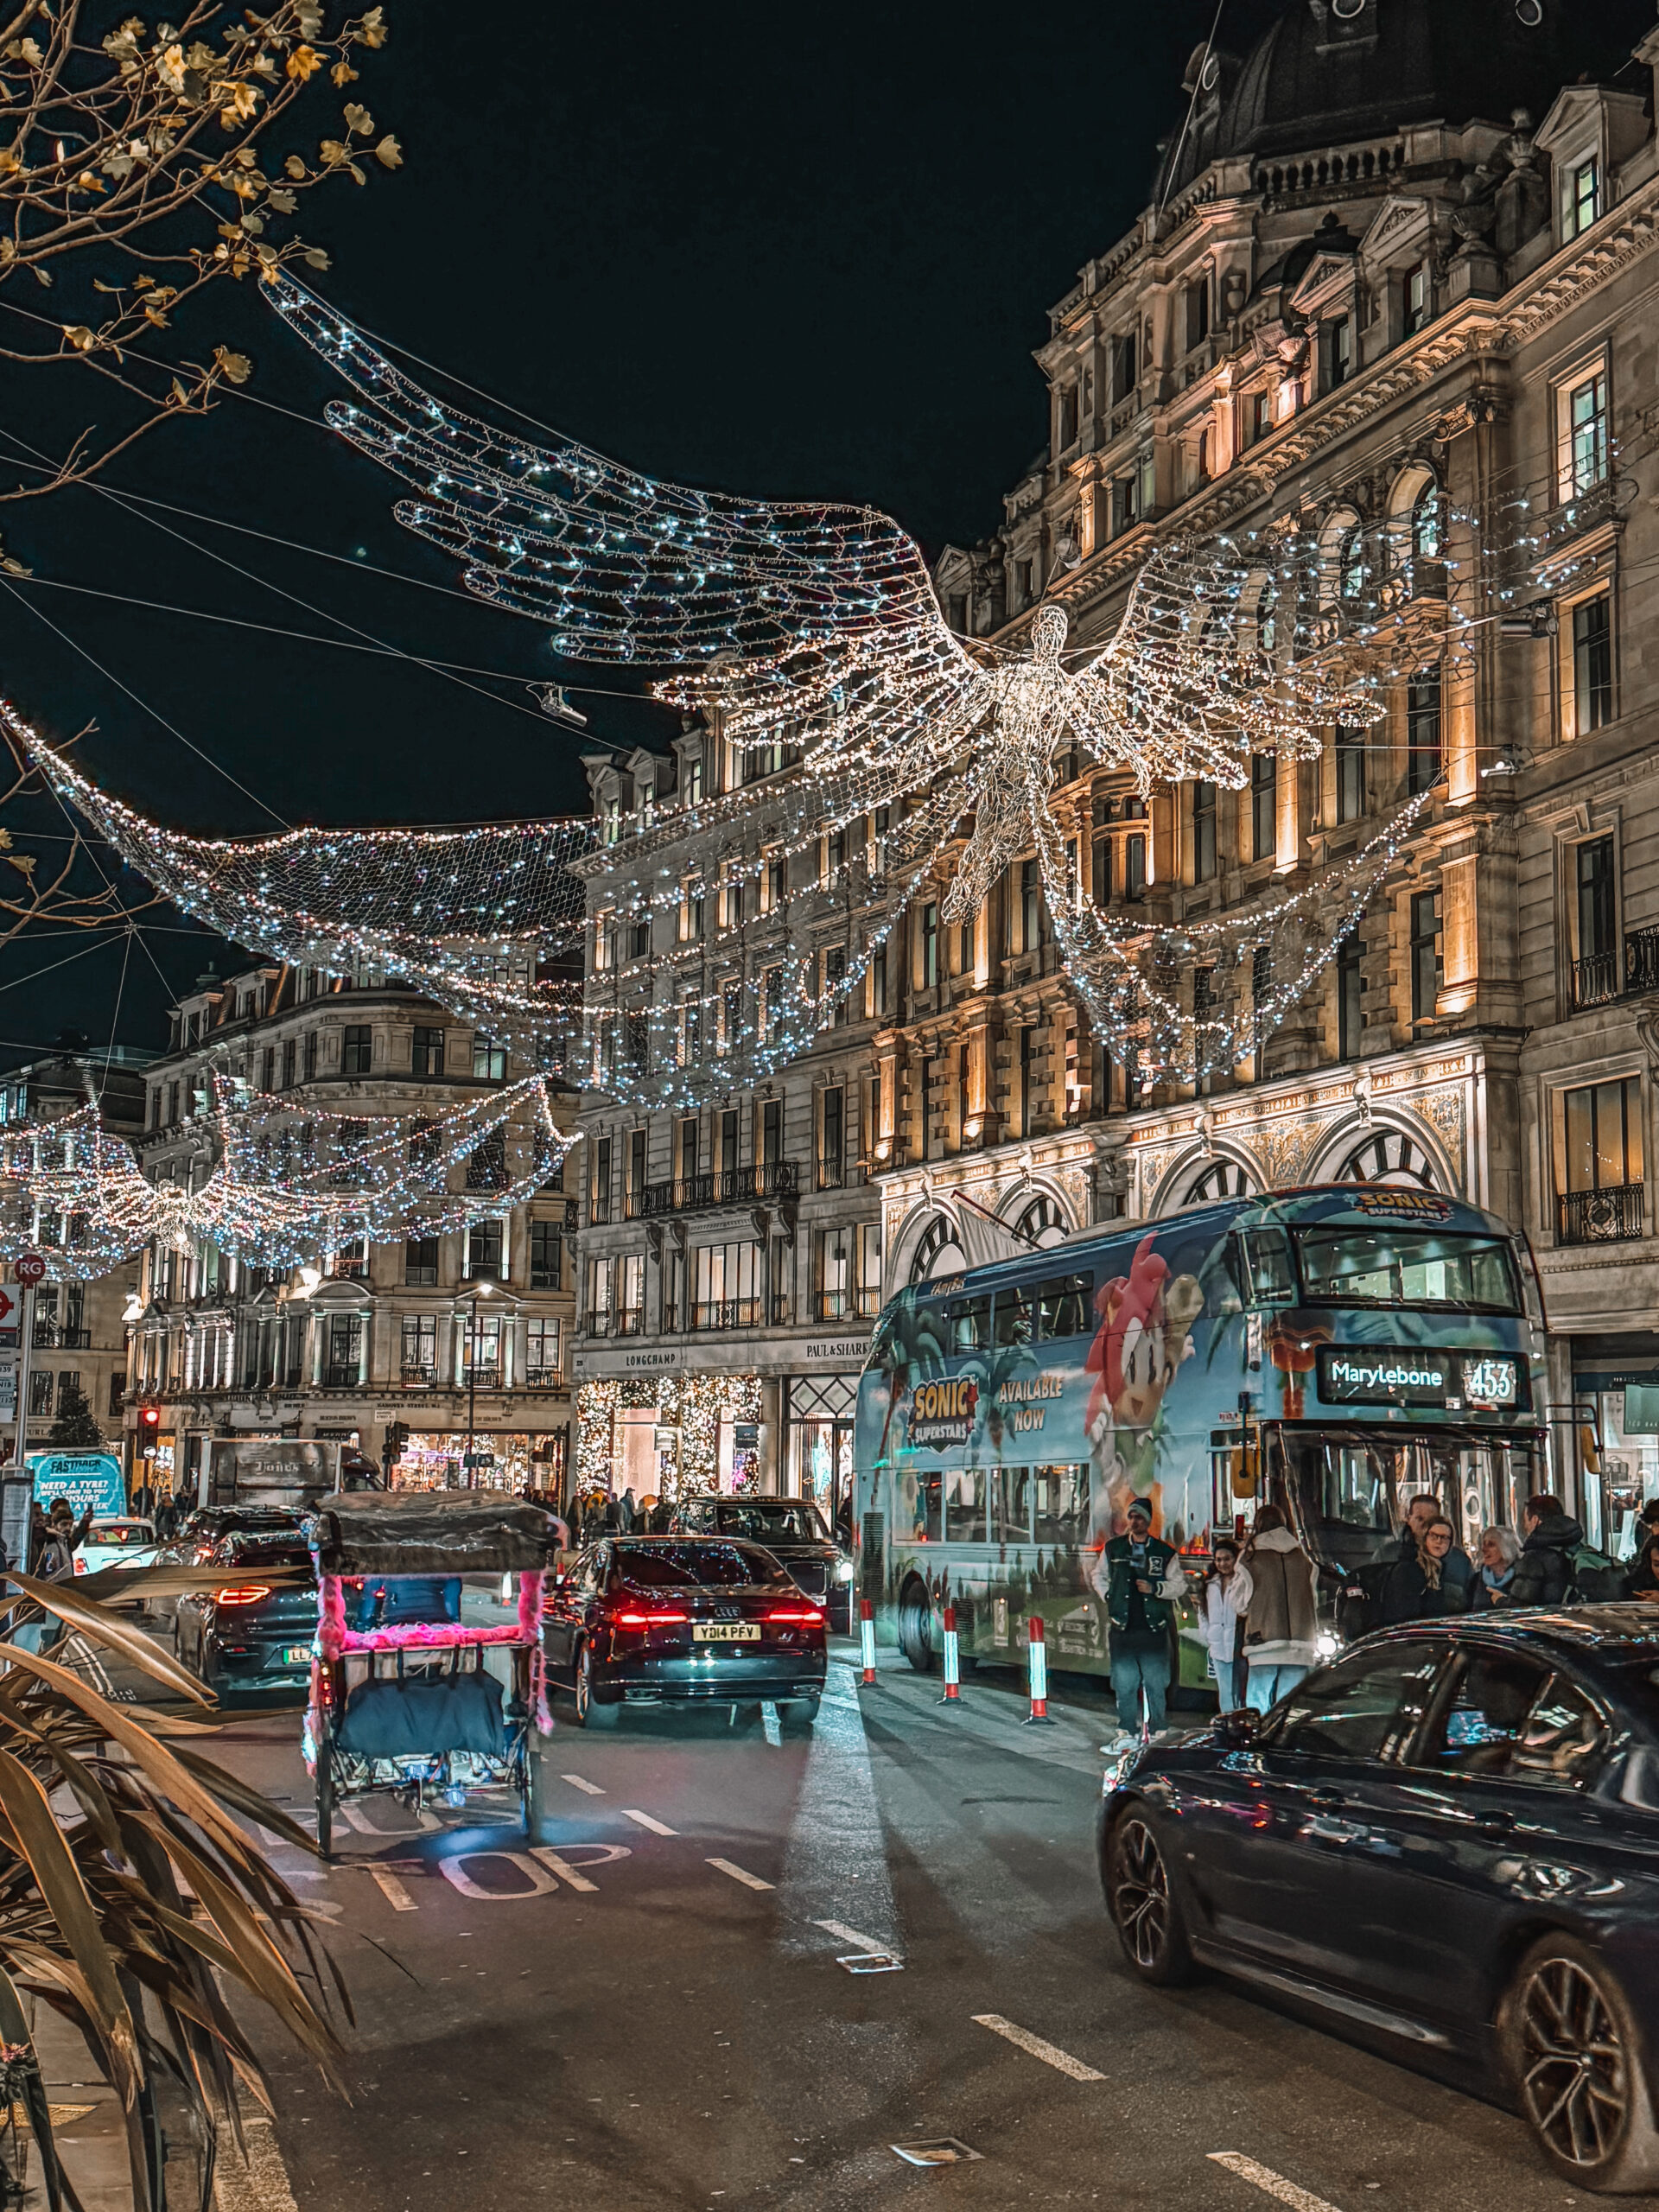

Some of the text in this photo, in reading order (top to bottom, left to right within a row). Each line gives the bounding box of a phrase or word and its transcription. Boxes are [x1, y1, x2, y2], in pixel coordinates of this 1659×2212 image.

[1359, 1193, 1439, 1210] SONIC
[19, 1262, 41, 1275] RG
[626, 1353, 676, 1367] LONGCHAMP
[1332, 1361, 1511, 1397] Marylebone 453
[999, 1376, 1065, 1404] AVAILABLE
[915, 1380, 969, 1421] SONIC
[1014, 1409, 1046, 1432] NOW
[915, 1422, 967, 1444] SUPERSTARS
[40, 1479, 109, 1491] NEED A TYRE?
[701, 1626, 728, 1639] YD14
